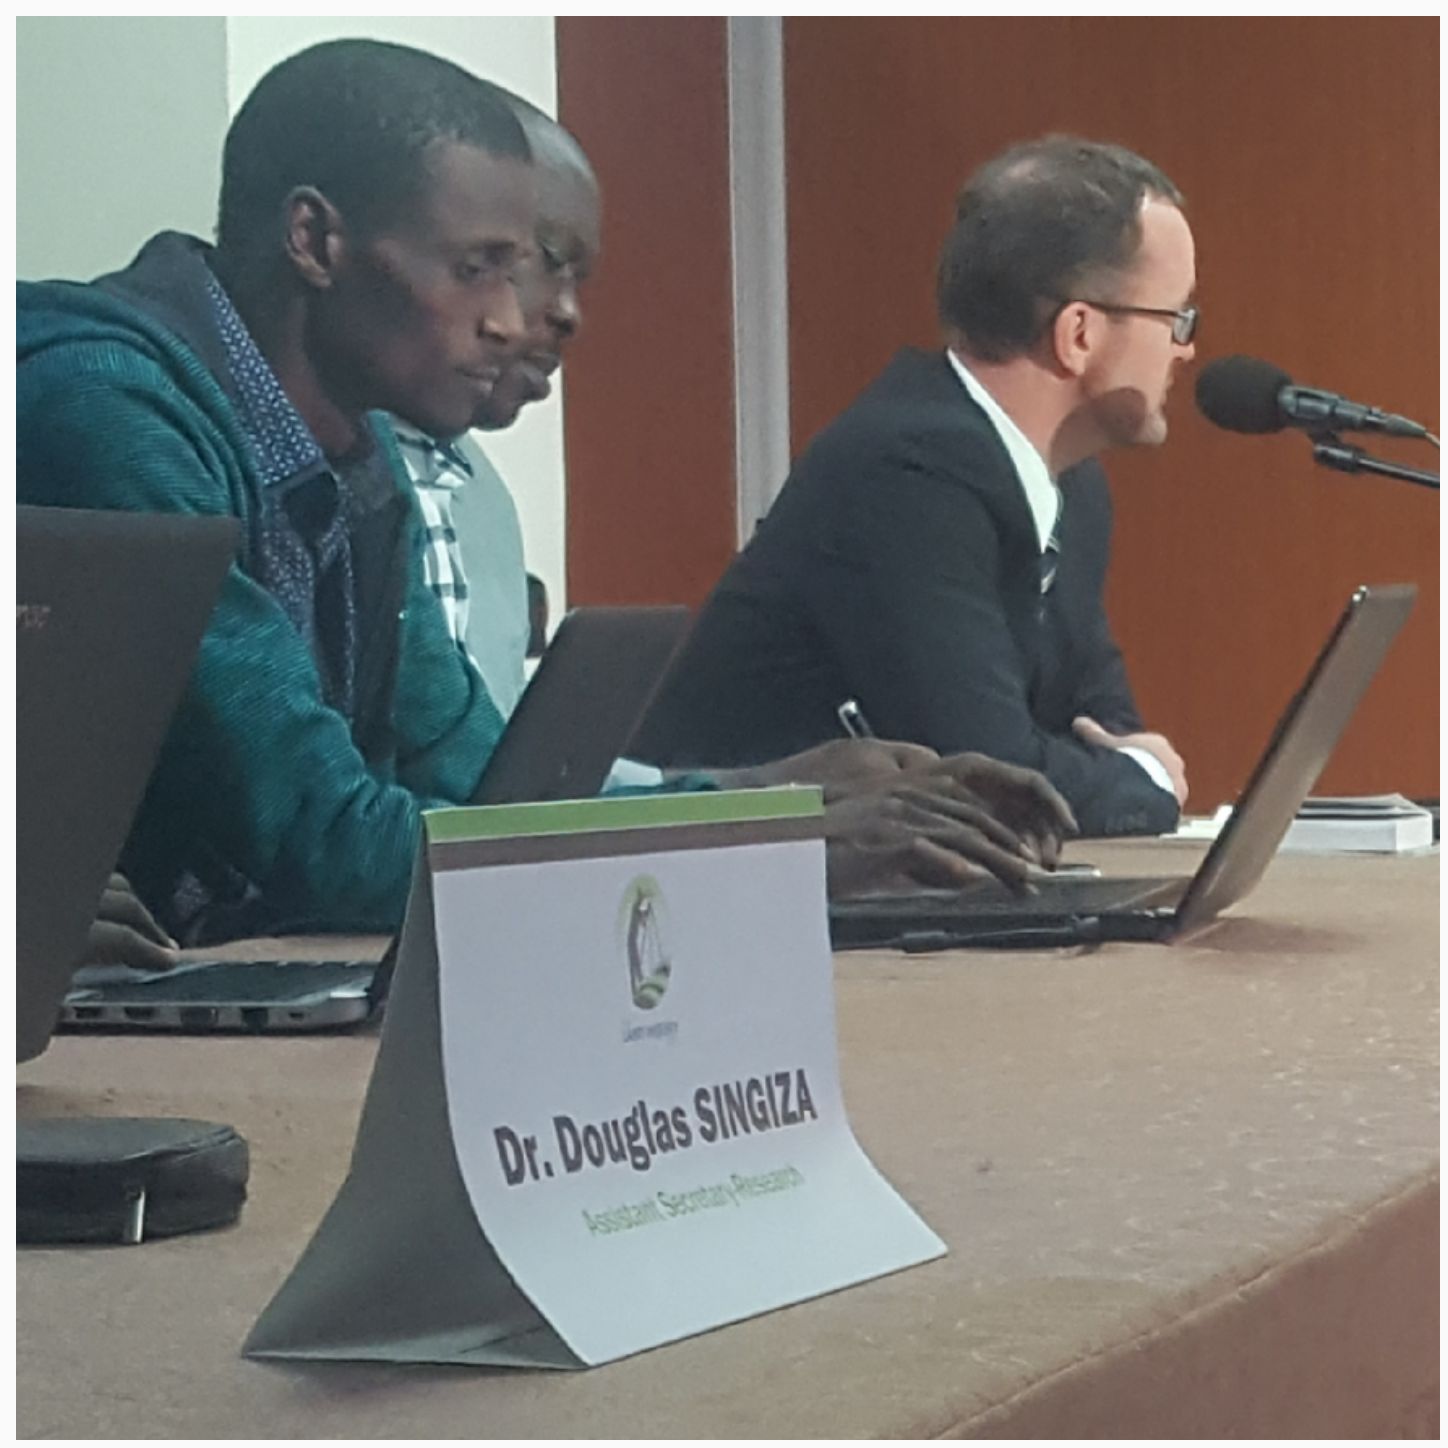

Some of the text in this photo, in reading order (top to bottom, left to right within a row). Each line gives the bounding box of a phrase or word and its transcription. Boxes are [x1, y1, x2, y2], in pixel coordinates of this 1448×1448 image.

[493, 1068, 818, 1187] Dr. Douglas SINGIZA
[581, 1198, 665, 1237] Assistant
